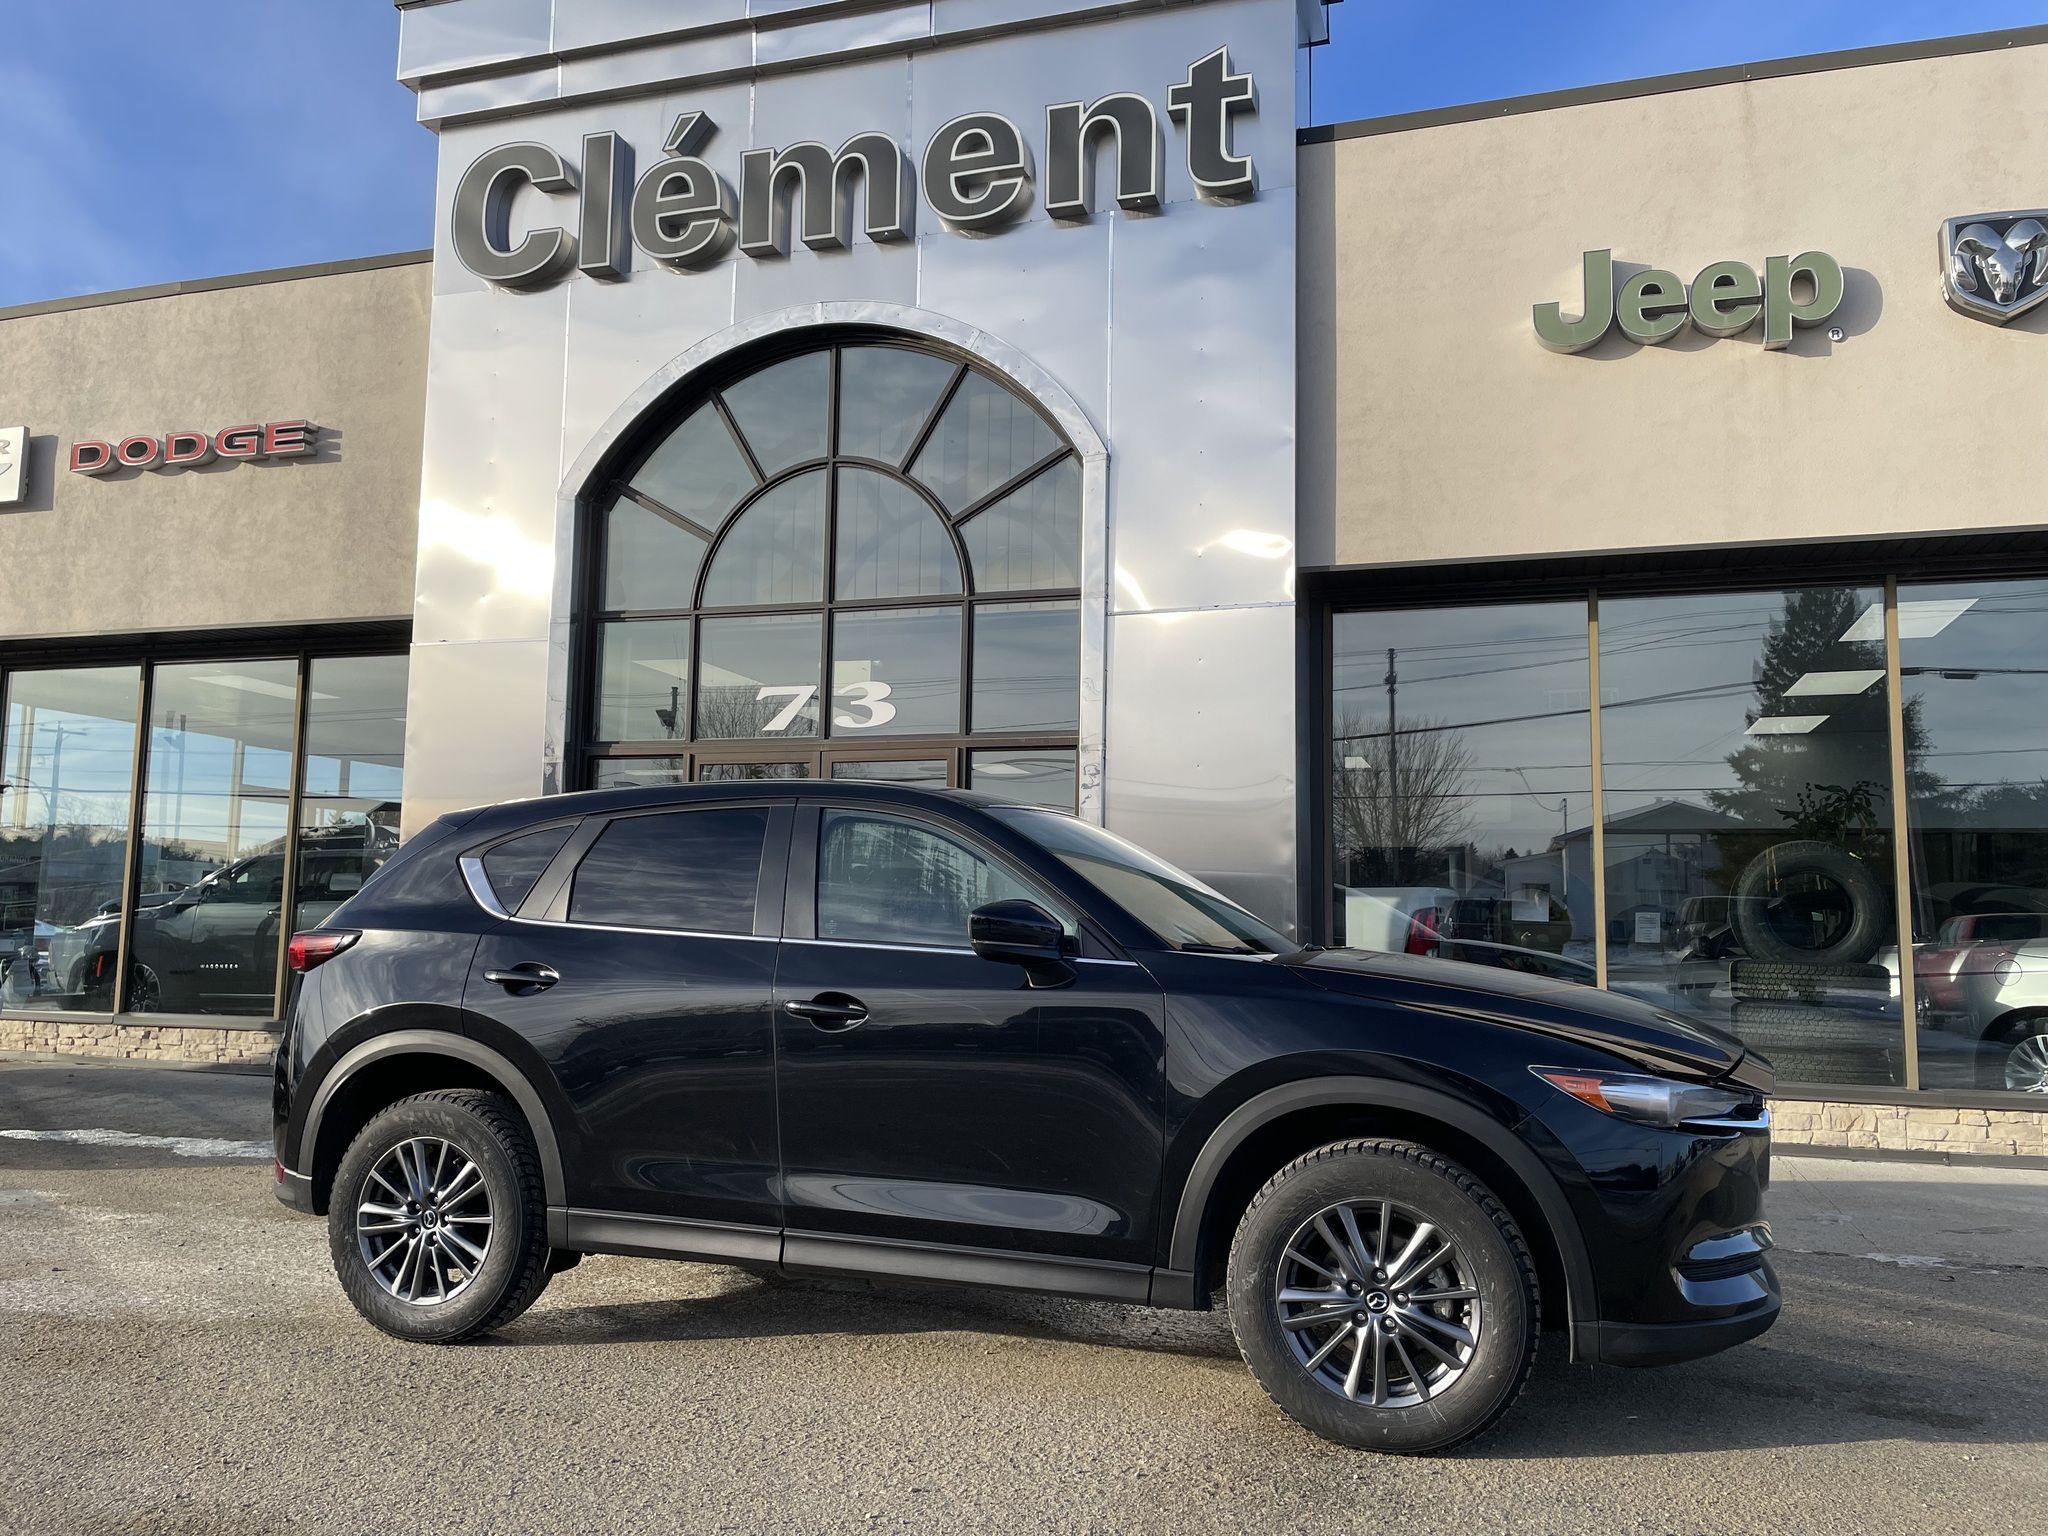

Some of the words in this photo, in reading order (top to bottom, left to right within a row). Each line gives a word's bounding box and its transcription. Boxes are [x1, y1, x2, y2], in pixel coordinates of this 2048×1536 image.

[452, 44, 1257, 287] Clément
[1533, 248, 1844, 352] Jeep
[70, 420, 318, 476] DODGE
[755, 680, 897, 731] 73
